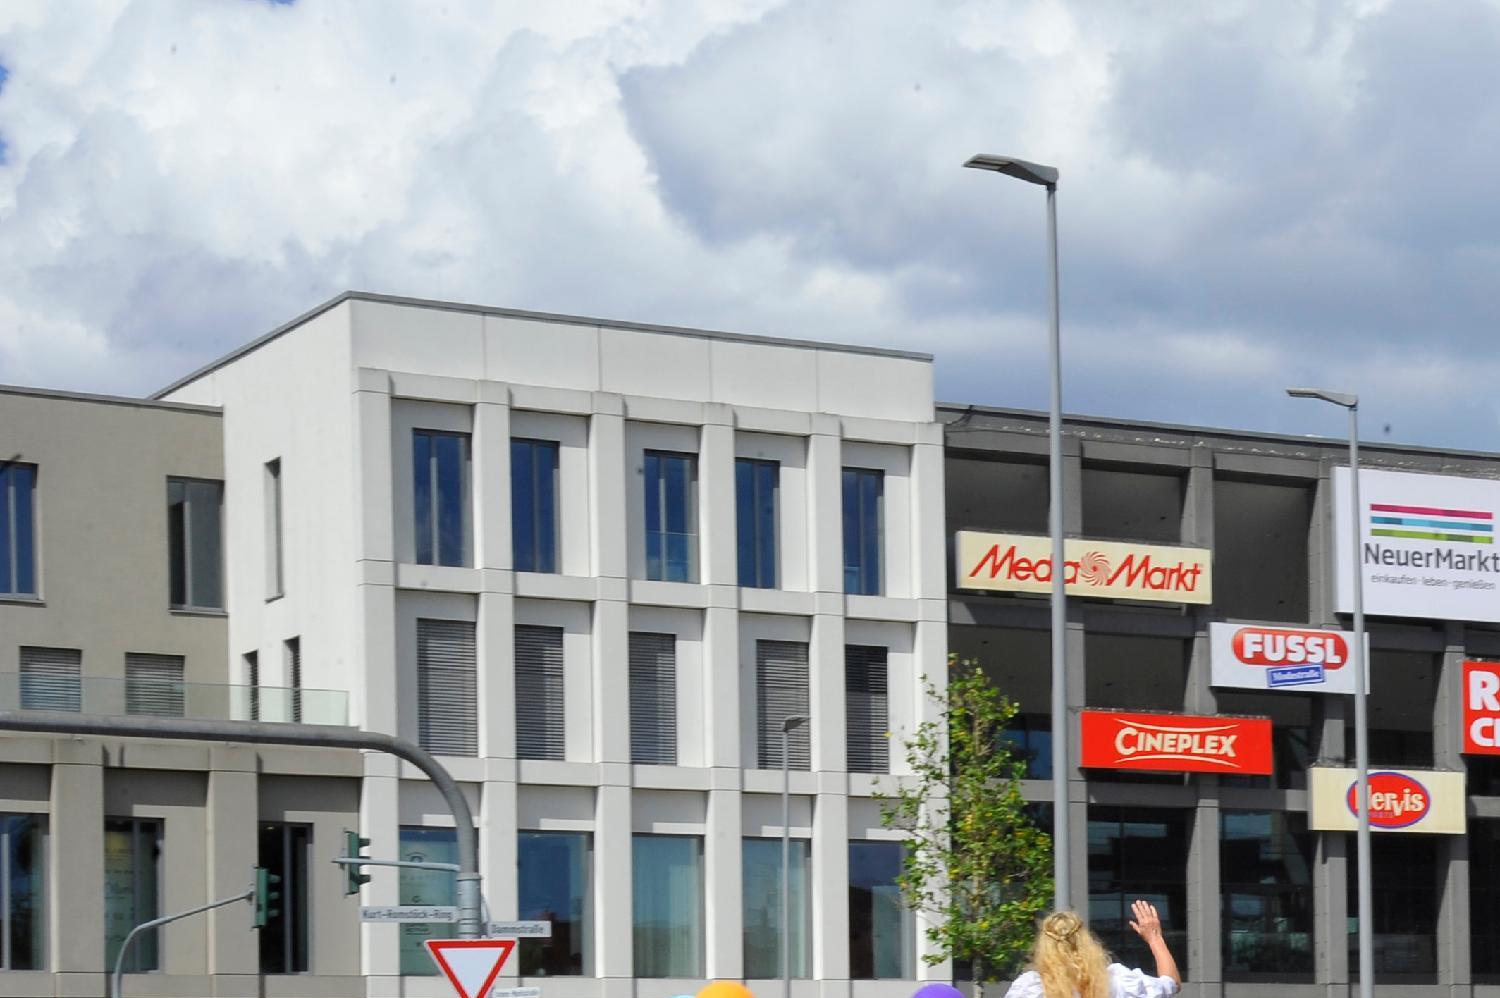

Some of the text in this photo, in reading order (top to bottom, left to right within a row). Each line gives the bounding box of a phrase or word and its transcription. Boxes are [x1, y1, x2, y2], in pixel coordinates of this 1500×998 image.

[969, 544, 1201, 592] Meda Markt
[1364, 543, 1500, 573] NeuerMarkt
[1371, 573, 1417, 585] einkaufen
[1243, 633, 1342, 664] FUSSL
[1114, 727, 1239, 757] CINEPLEX
